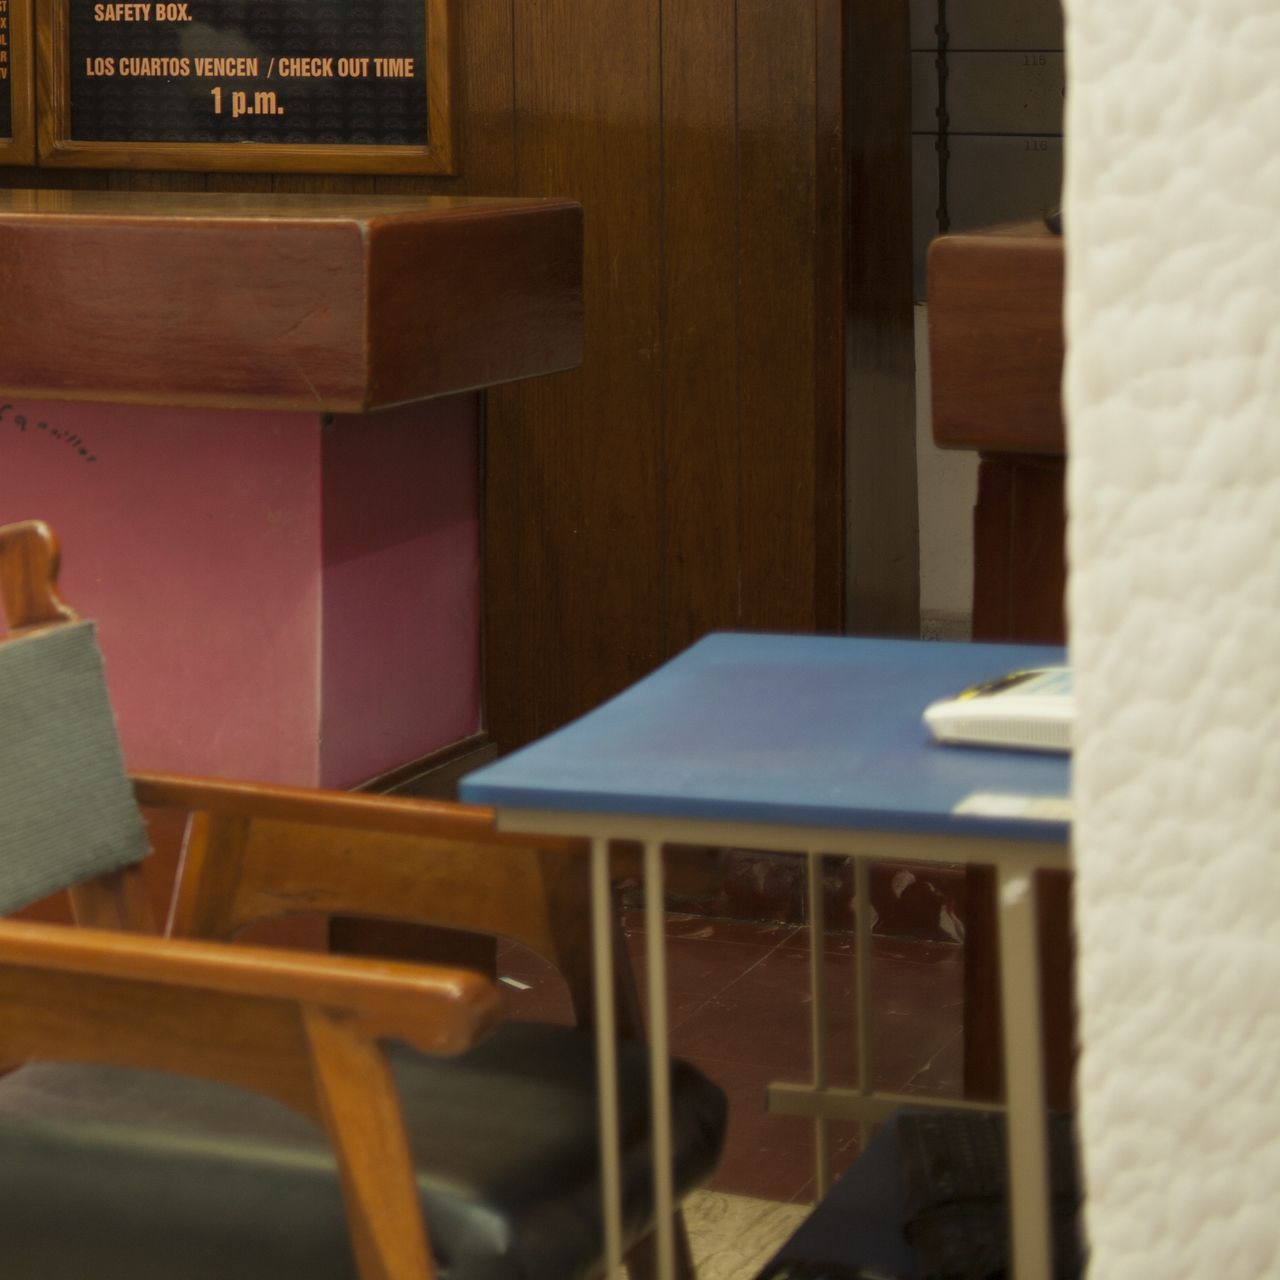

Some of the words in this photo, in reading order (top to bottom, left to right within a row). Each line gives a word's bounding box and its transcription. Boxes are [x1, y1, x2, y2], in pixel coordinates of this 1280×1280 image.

[94, 3, 151, 21] SAFETY
[155, 3, 193, 21] BOX.
[86, 57, 115, 77] LOS
[119, 57, 190, 77] CUARTOS
[194, 57, 258, 77] VENCEN
[278, 57, 333, 77] CHECK
[337, 58, 369, 77] OUT
[374, 58, 414, 78] TIME
[211, 86, 222, 114] 1
[232, 90, 284, 118] p.m.
